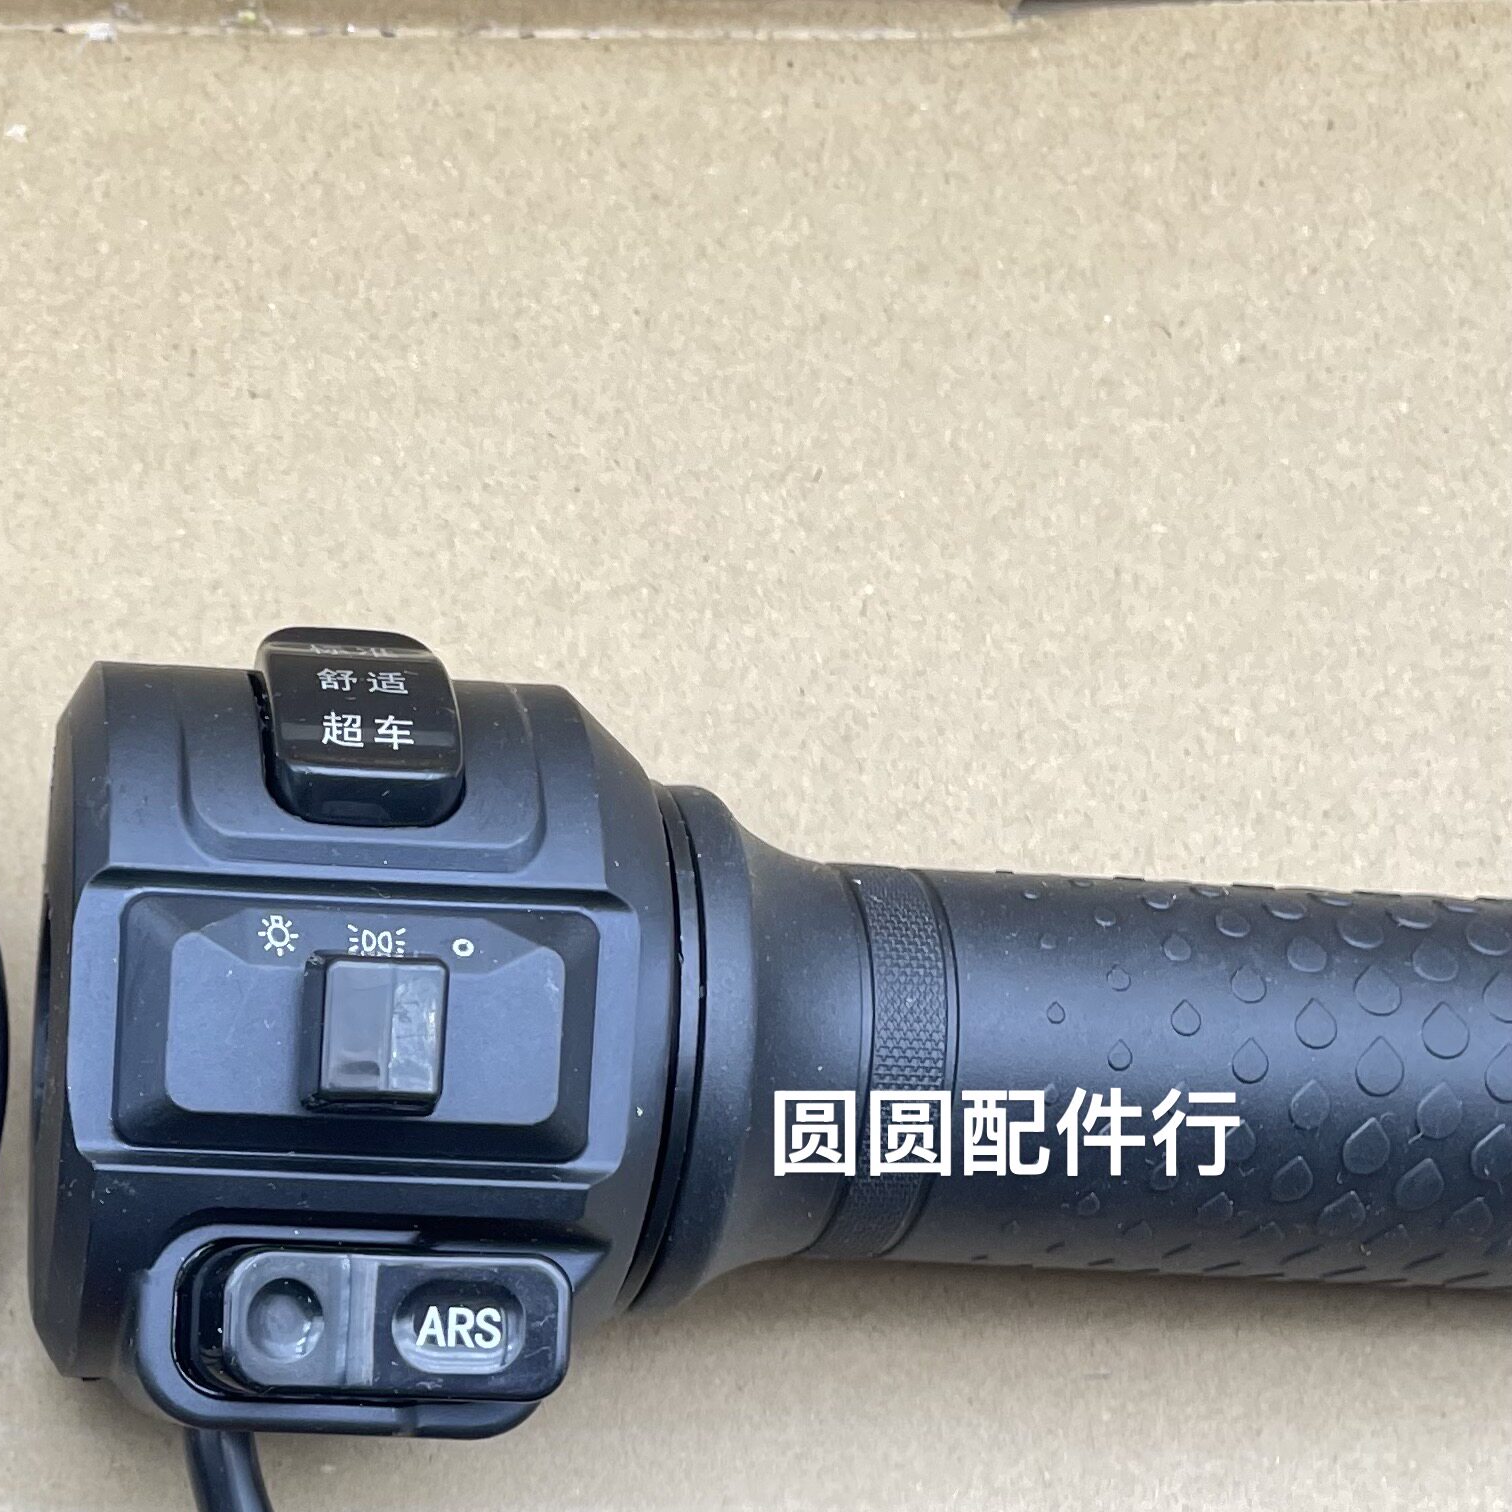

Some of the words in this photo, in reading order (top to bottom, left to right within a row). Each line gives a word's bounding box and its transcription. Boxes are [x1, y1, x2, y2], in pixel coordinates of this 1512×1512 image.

[317, 668, 409, 695] 舒适
[321, 711, 415, 751] 超车
[415, 1305, 501, 1349] ARS
